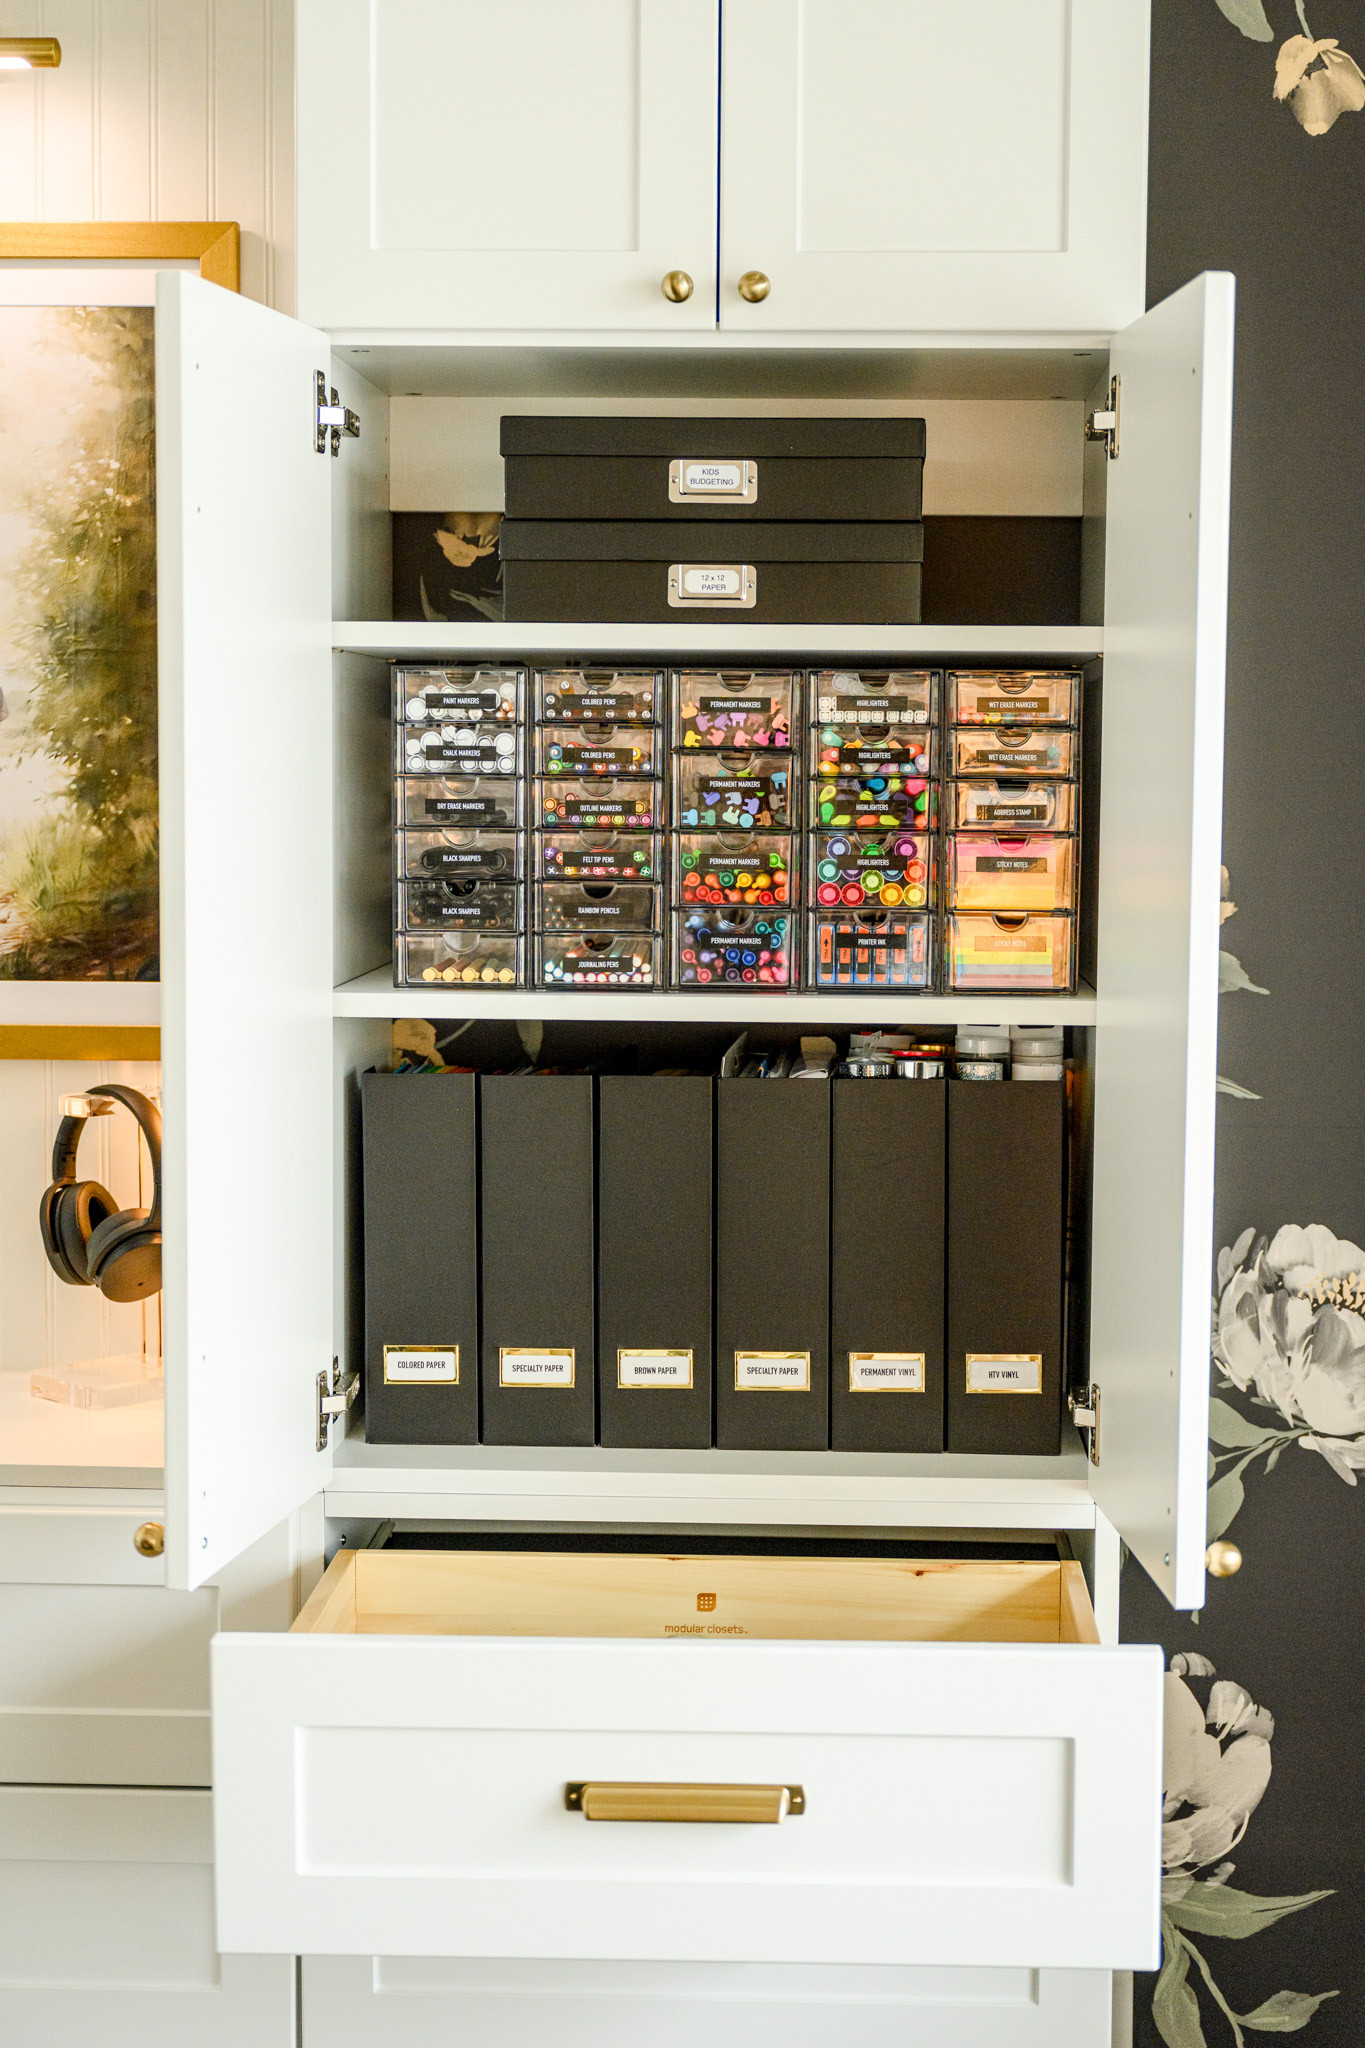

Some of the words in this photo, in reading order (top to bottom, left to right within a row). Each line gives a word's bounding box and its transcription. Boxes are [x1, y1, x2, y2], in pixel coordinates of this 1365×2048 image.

[634, 1367, 656, 1375] BROWN
[657, 1367, 677, 1375] PAPER
[747, 1367, 778, 1375] SPECIALTY
[779, 1367, 798, 1375] PAPER
[664, 1624, 705, 1633] modular
